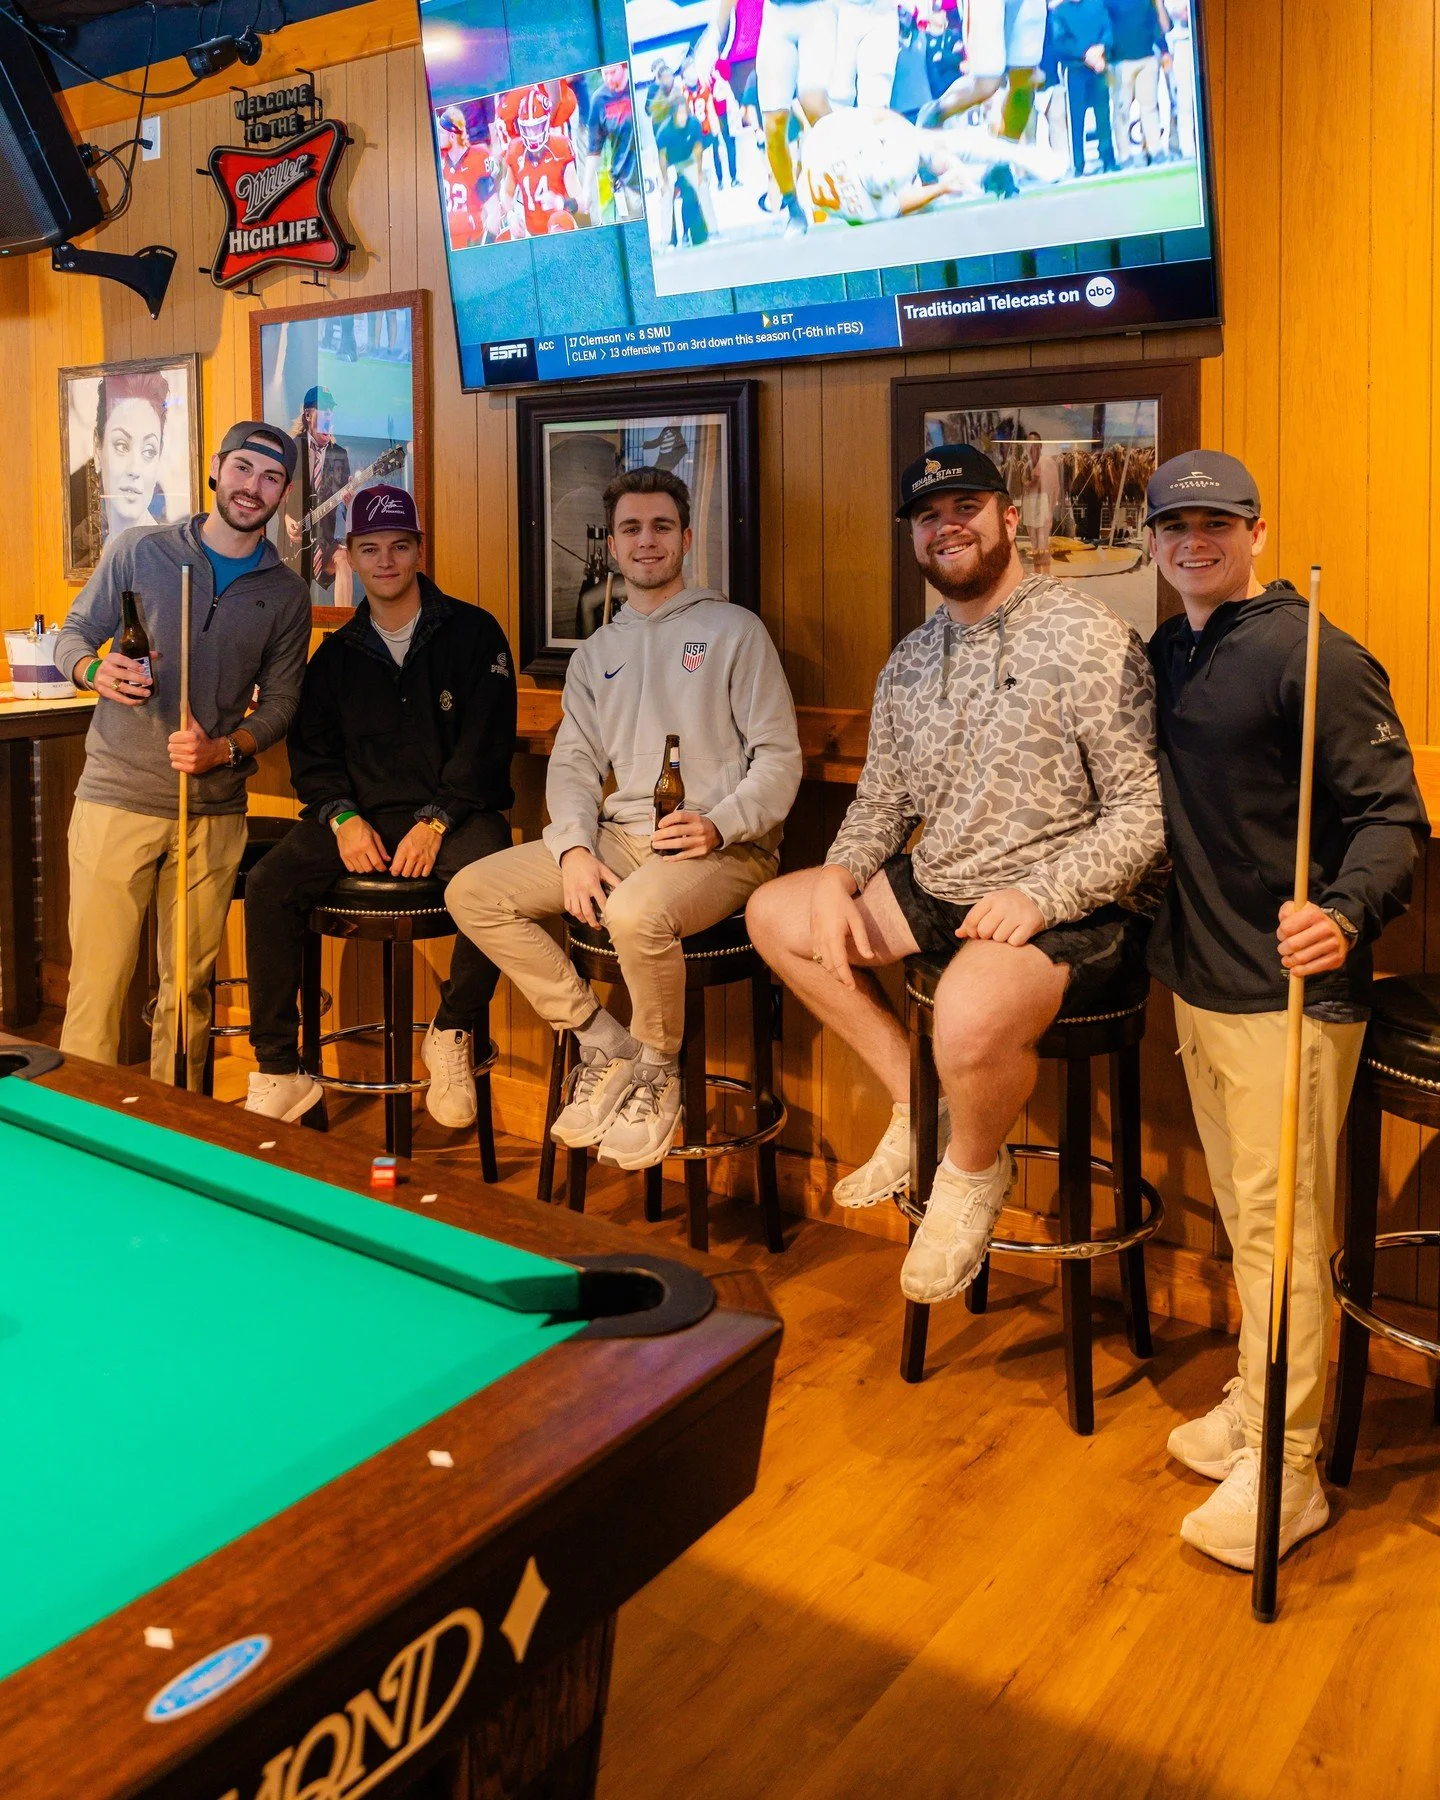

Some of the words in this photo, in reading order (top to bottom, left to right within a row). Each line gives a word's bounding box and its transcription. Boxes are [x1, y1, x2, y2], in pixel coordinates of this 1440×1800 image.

[235, 85, 309, 118] WELCOME
[245, 123, 264, 141] TO
[269, 115, 299, 137] THE
[235, 154, 310, 223] Miller
[229, 225, 275, 254] HIGH
[277, 217, 319, 246] LIFE
[1088, 284, 1113, 297] abc
[903, 297, 985, 319] Traditional
[988, 289, 1055, 311] Telecast
[1058, 289, 1080, 303] on
[772, 315, 780, 325] 8
[781, 314, 794, 325] ET
[538, 341, 555, 351] ACC
[569, 337, 578, 348] 17
[579, 333, 622, 347] Clemson
[625, 332, 636, 342] vs
[639, 330, 646, 340] 8
[647, 326, 672, 339] SMU
[572, 351, 597, 362] CLEM
[610, 348, 620, 358] 13
[621, 344, 661, 357] offensive
[661, 342, 675, 353] TD
[677, 342, 689, 351] on
[690, 337, 707, 350] 3rd
[708, 334, 734, 348] down
[735, 332, 754, 345] this
[755, 330, 791, 343] season
[792, 325, 824, 341] (T-6th
[825, 325, 835, 336] in
[837, 320, 864, 335] FBS)
[489, 343, 528, 361] ESPN
[911, 474, 933, 490] TEXAS
[936, 467, 963, 478] STATE
[686, 644, 705, 656] USA
